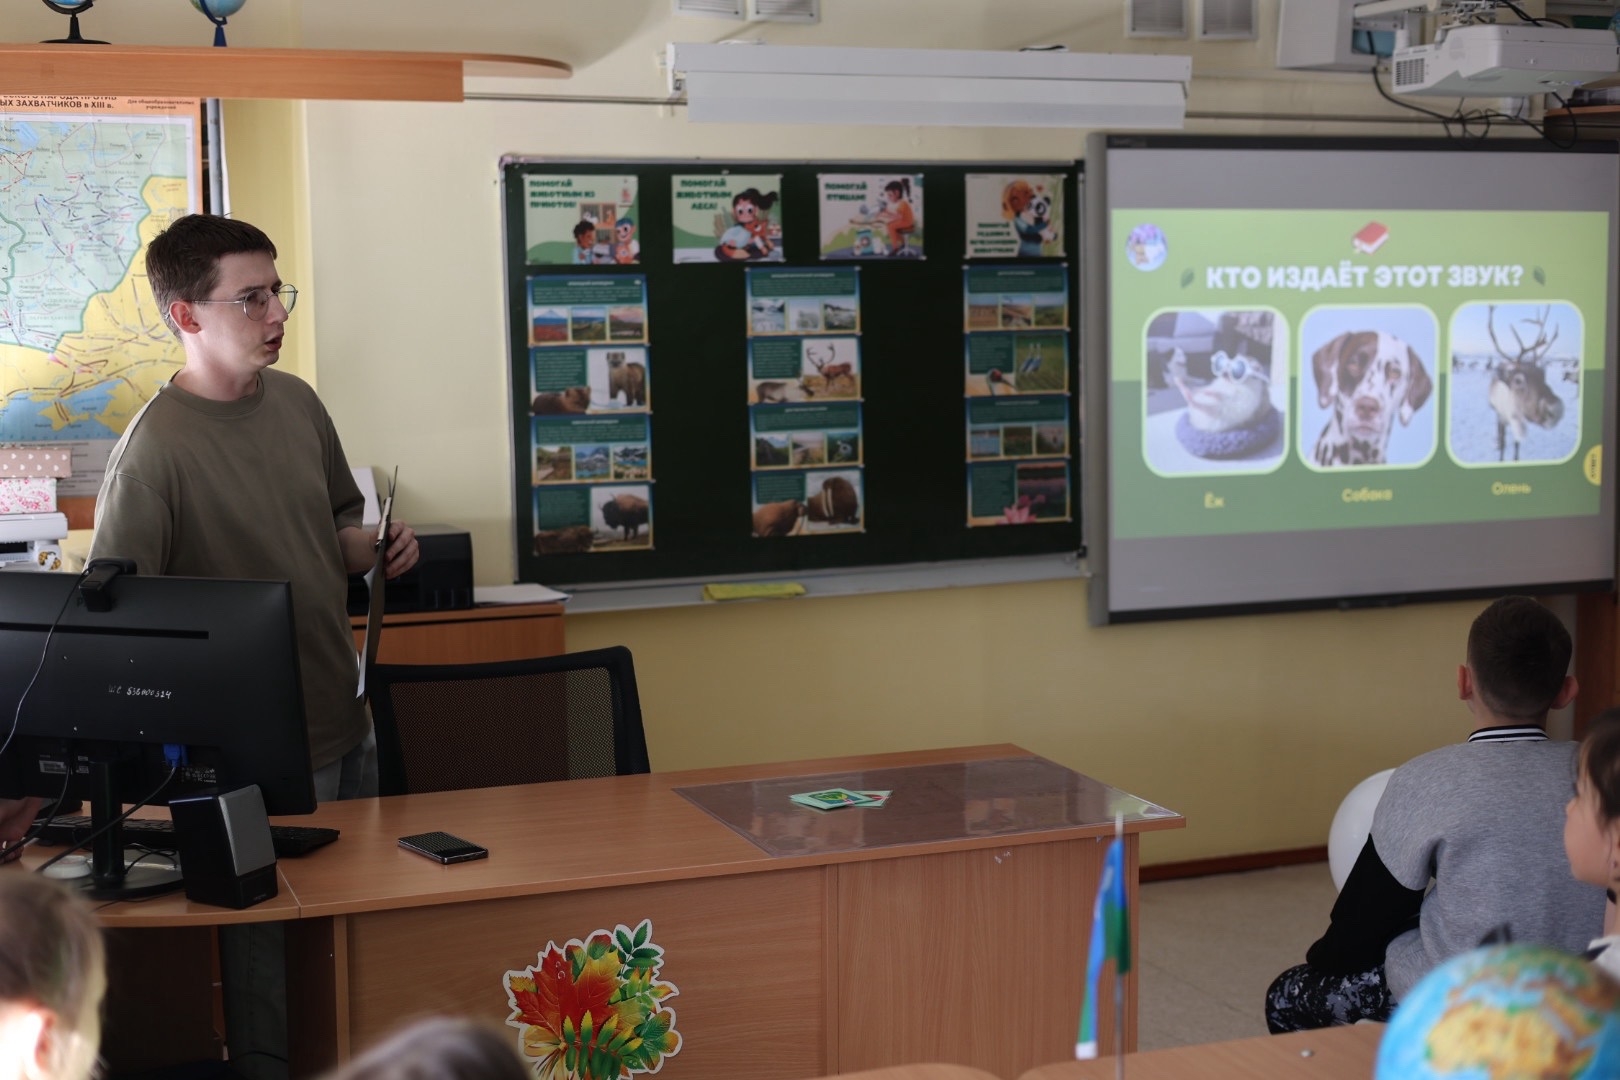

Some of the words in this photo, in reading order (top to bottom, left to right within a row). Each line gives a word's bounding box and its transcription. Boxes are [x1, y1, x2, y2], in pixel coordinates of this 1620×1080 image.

[16, 99, 82, 108] ЗАХВАТЧИКОВ
[1206, 266, 1262, 289] КТО
[1267, 260, 1370, 293] ИЗДАЁТ
[1373, 264, 1444, 288] ЭТОТ
[1447, 264, 1524, 287] ЗВУК?
